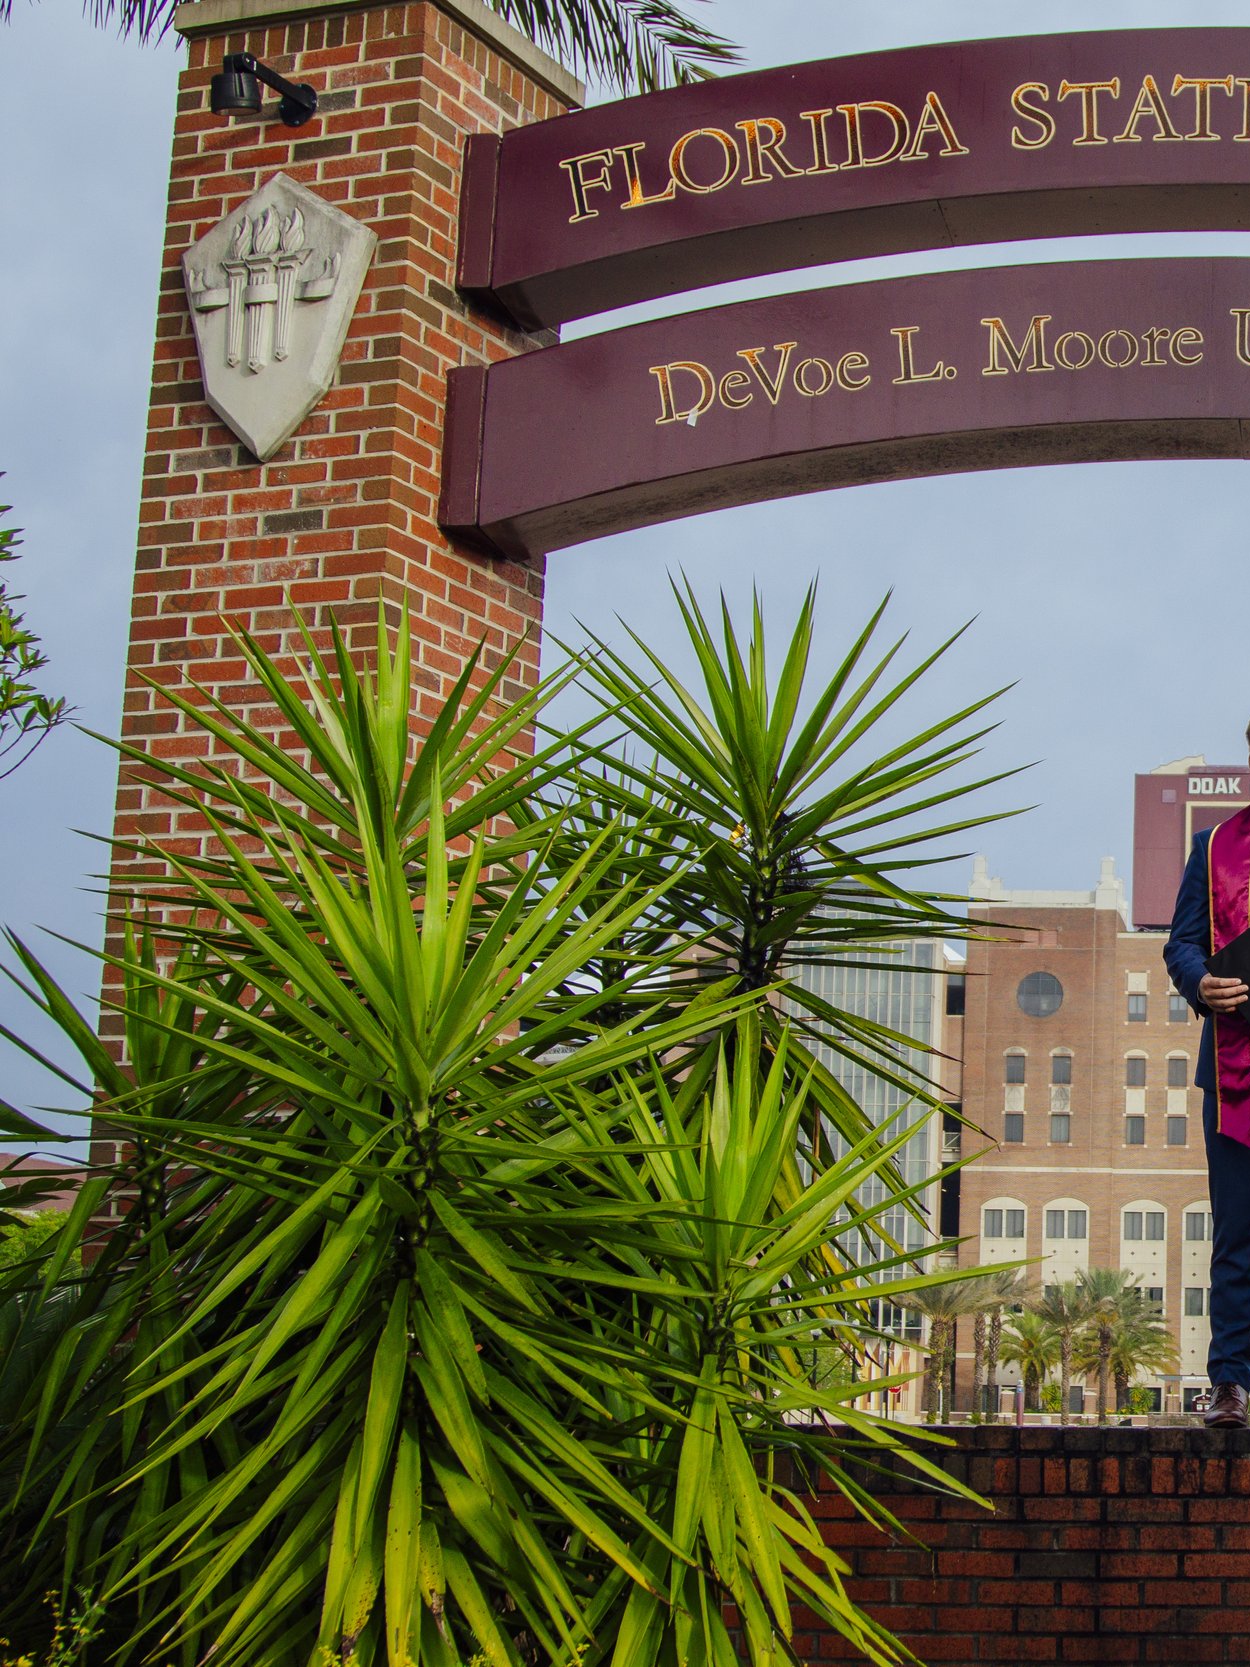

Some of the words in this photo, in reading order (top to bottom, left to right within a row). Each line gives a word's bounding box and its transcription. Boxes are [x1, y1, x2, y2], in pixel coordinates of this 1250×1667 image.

[559, 91, 969, 224] FLORIDA
[649, 341, 871, 425] DeVoe
[891, 326, 957, 385] L.
[980, 314, 1204, 376] Moore
[1188, 777, 1241, 794] DOAK
